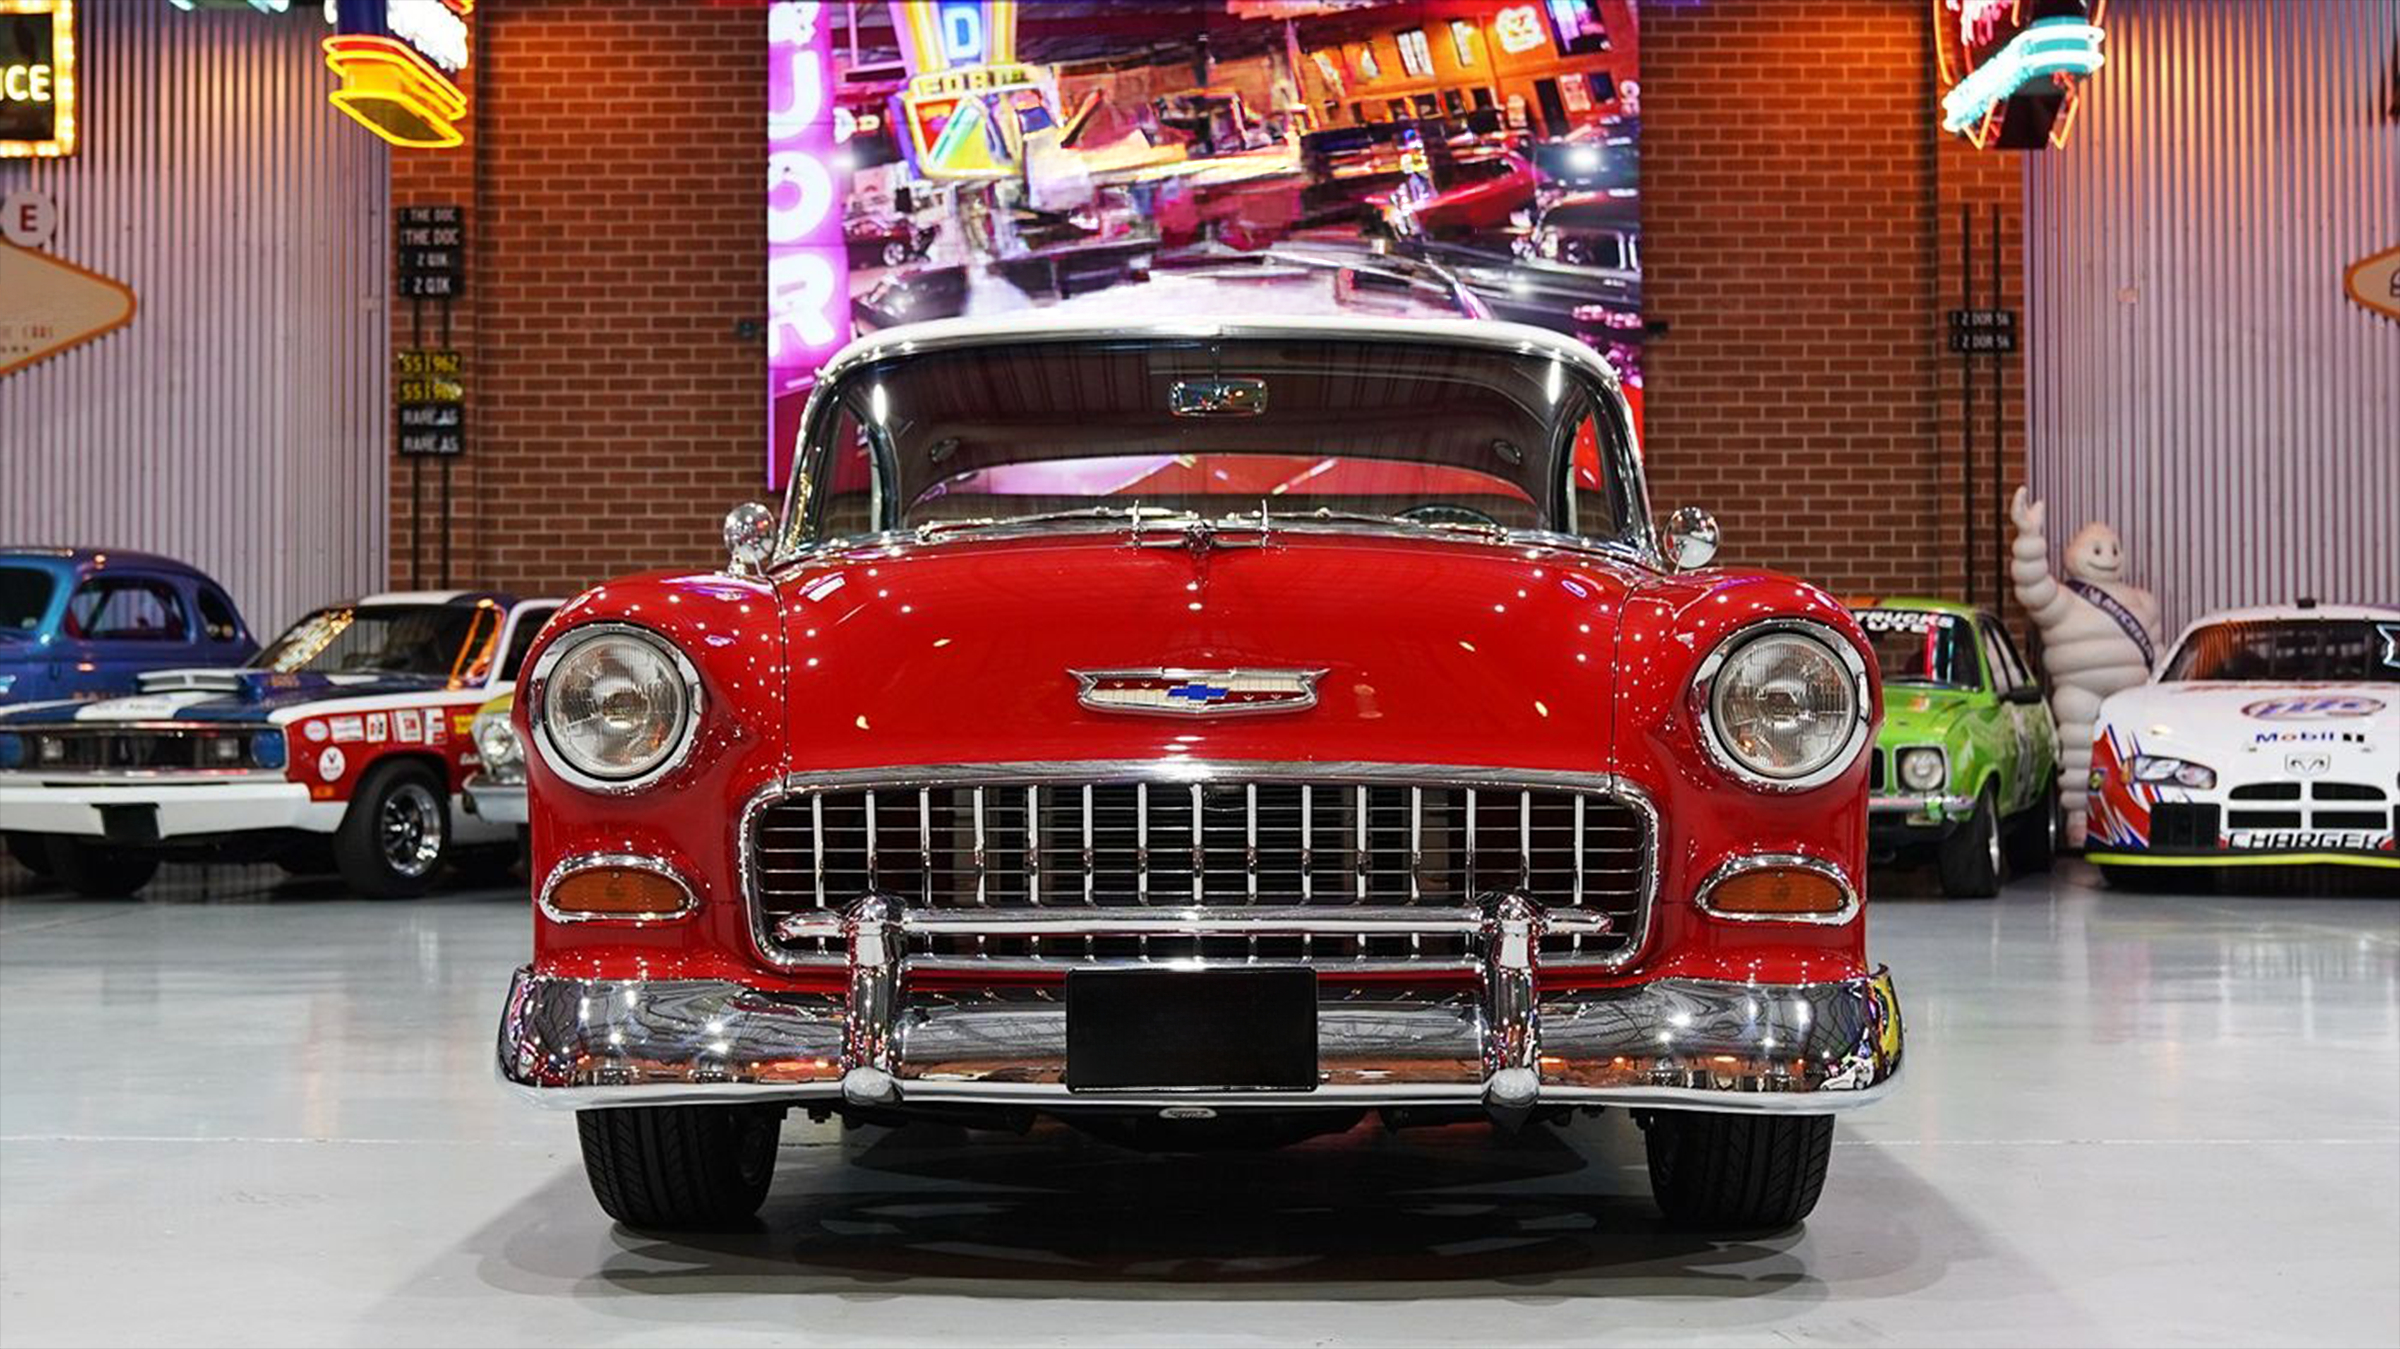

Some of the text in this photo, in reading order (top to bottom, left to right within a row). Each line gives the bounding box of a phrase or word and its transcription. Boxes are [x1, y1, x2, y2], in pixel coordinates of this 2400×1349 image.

[20, 204, 37, 232] E
[1853, 611, 1954, 629] TRUCKS
[2255, 732, 2335, 743] Mobil
